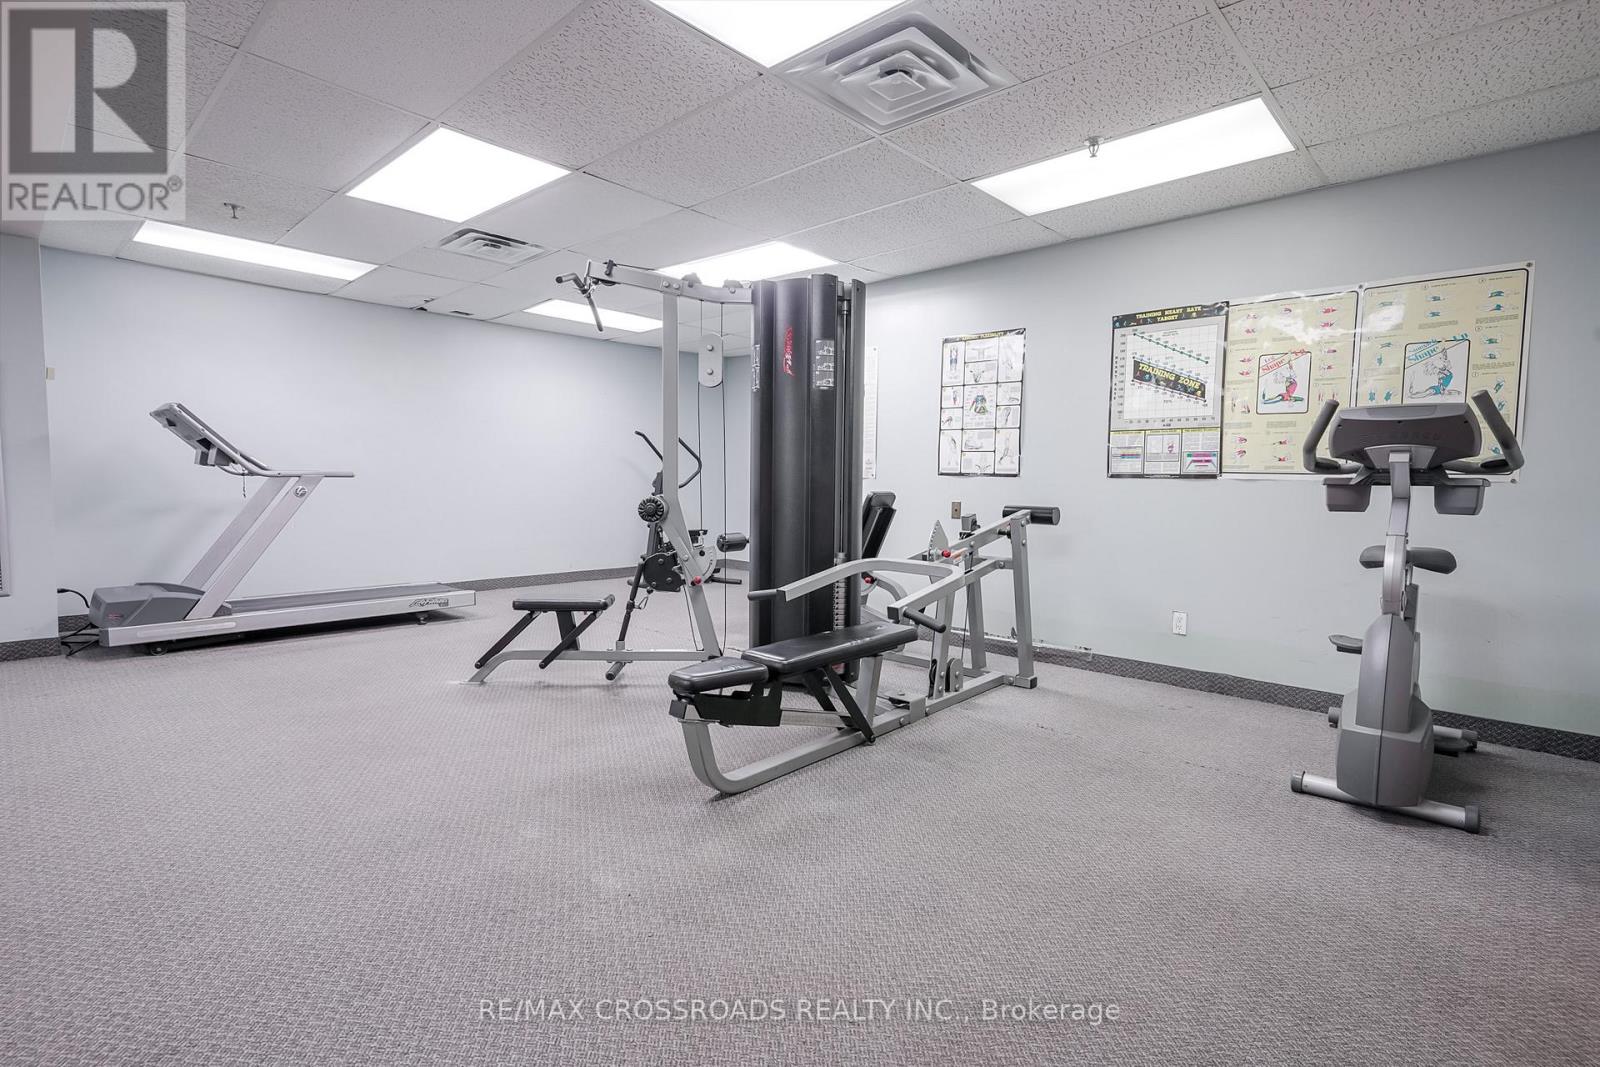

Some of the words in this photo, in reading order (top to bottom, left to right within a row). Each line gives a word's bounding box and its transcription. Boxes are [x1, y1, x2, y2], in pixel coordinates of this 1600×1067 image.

[1136, 311, 1161, 320] TRAINING
[1164, 308, 1183, 316] HEART
[1138, 363, 1176, 380] TRAINING
[1178, 376, 1201, 390] ZONE
